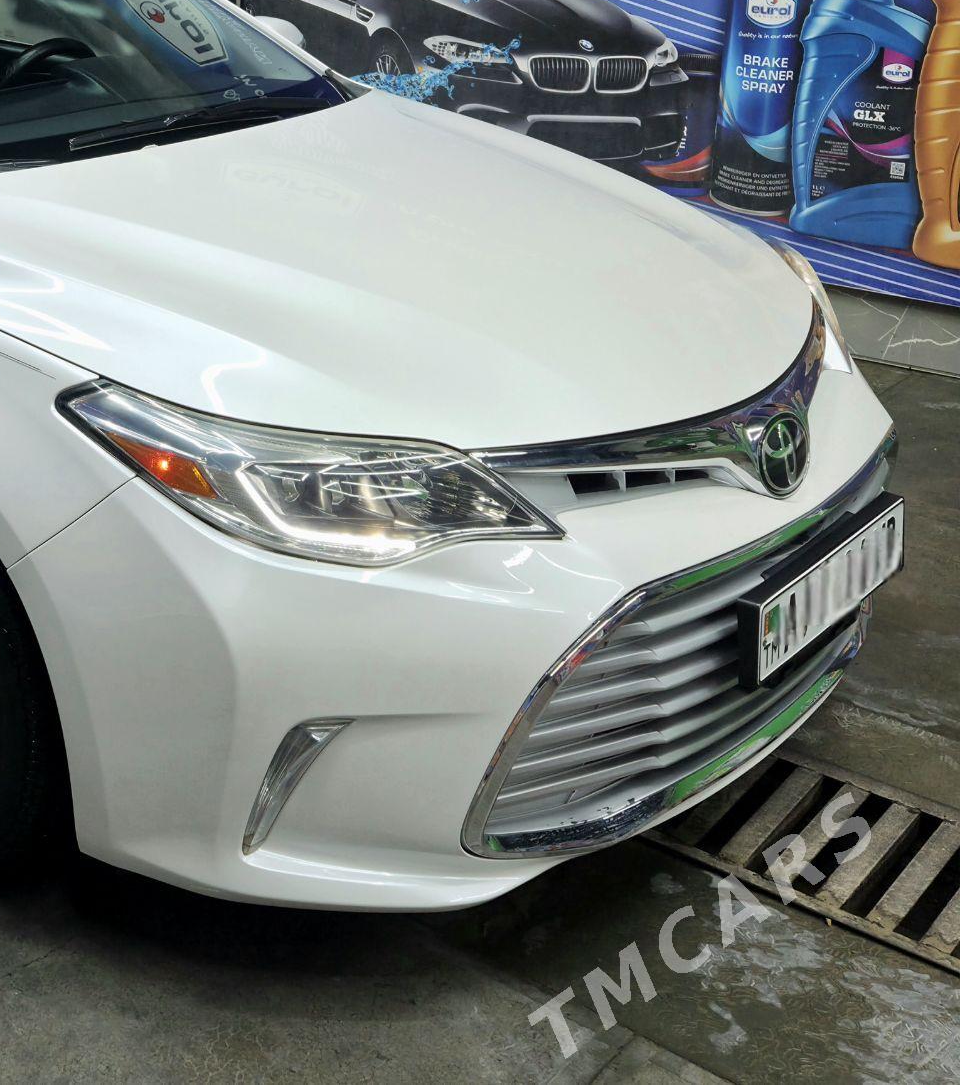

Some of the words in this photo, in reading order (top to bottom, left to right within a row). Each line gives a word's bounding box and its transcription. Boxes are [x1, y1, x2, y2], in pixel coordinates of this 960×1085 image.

[751, 5, 791, 16] eurol
[744, 54, 788, 68] BRAKE
[736, 66, 793, 81] CLEANER
[742, 80, 785, 94] SPRAY
[855, 101, 891, 110] COOLANT
[853, 109, 886, 122] GLX
[852, 122, 887, 130] PROTECTION
